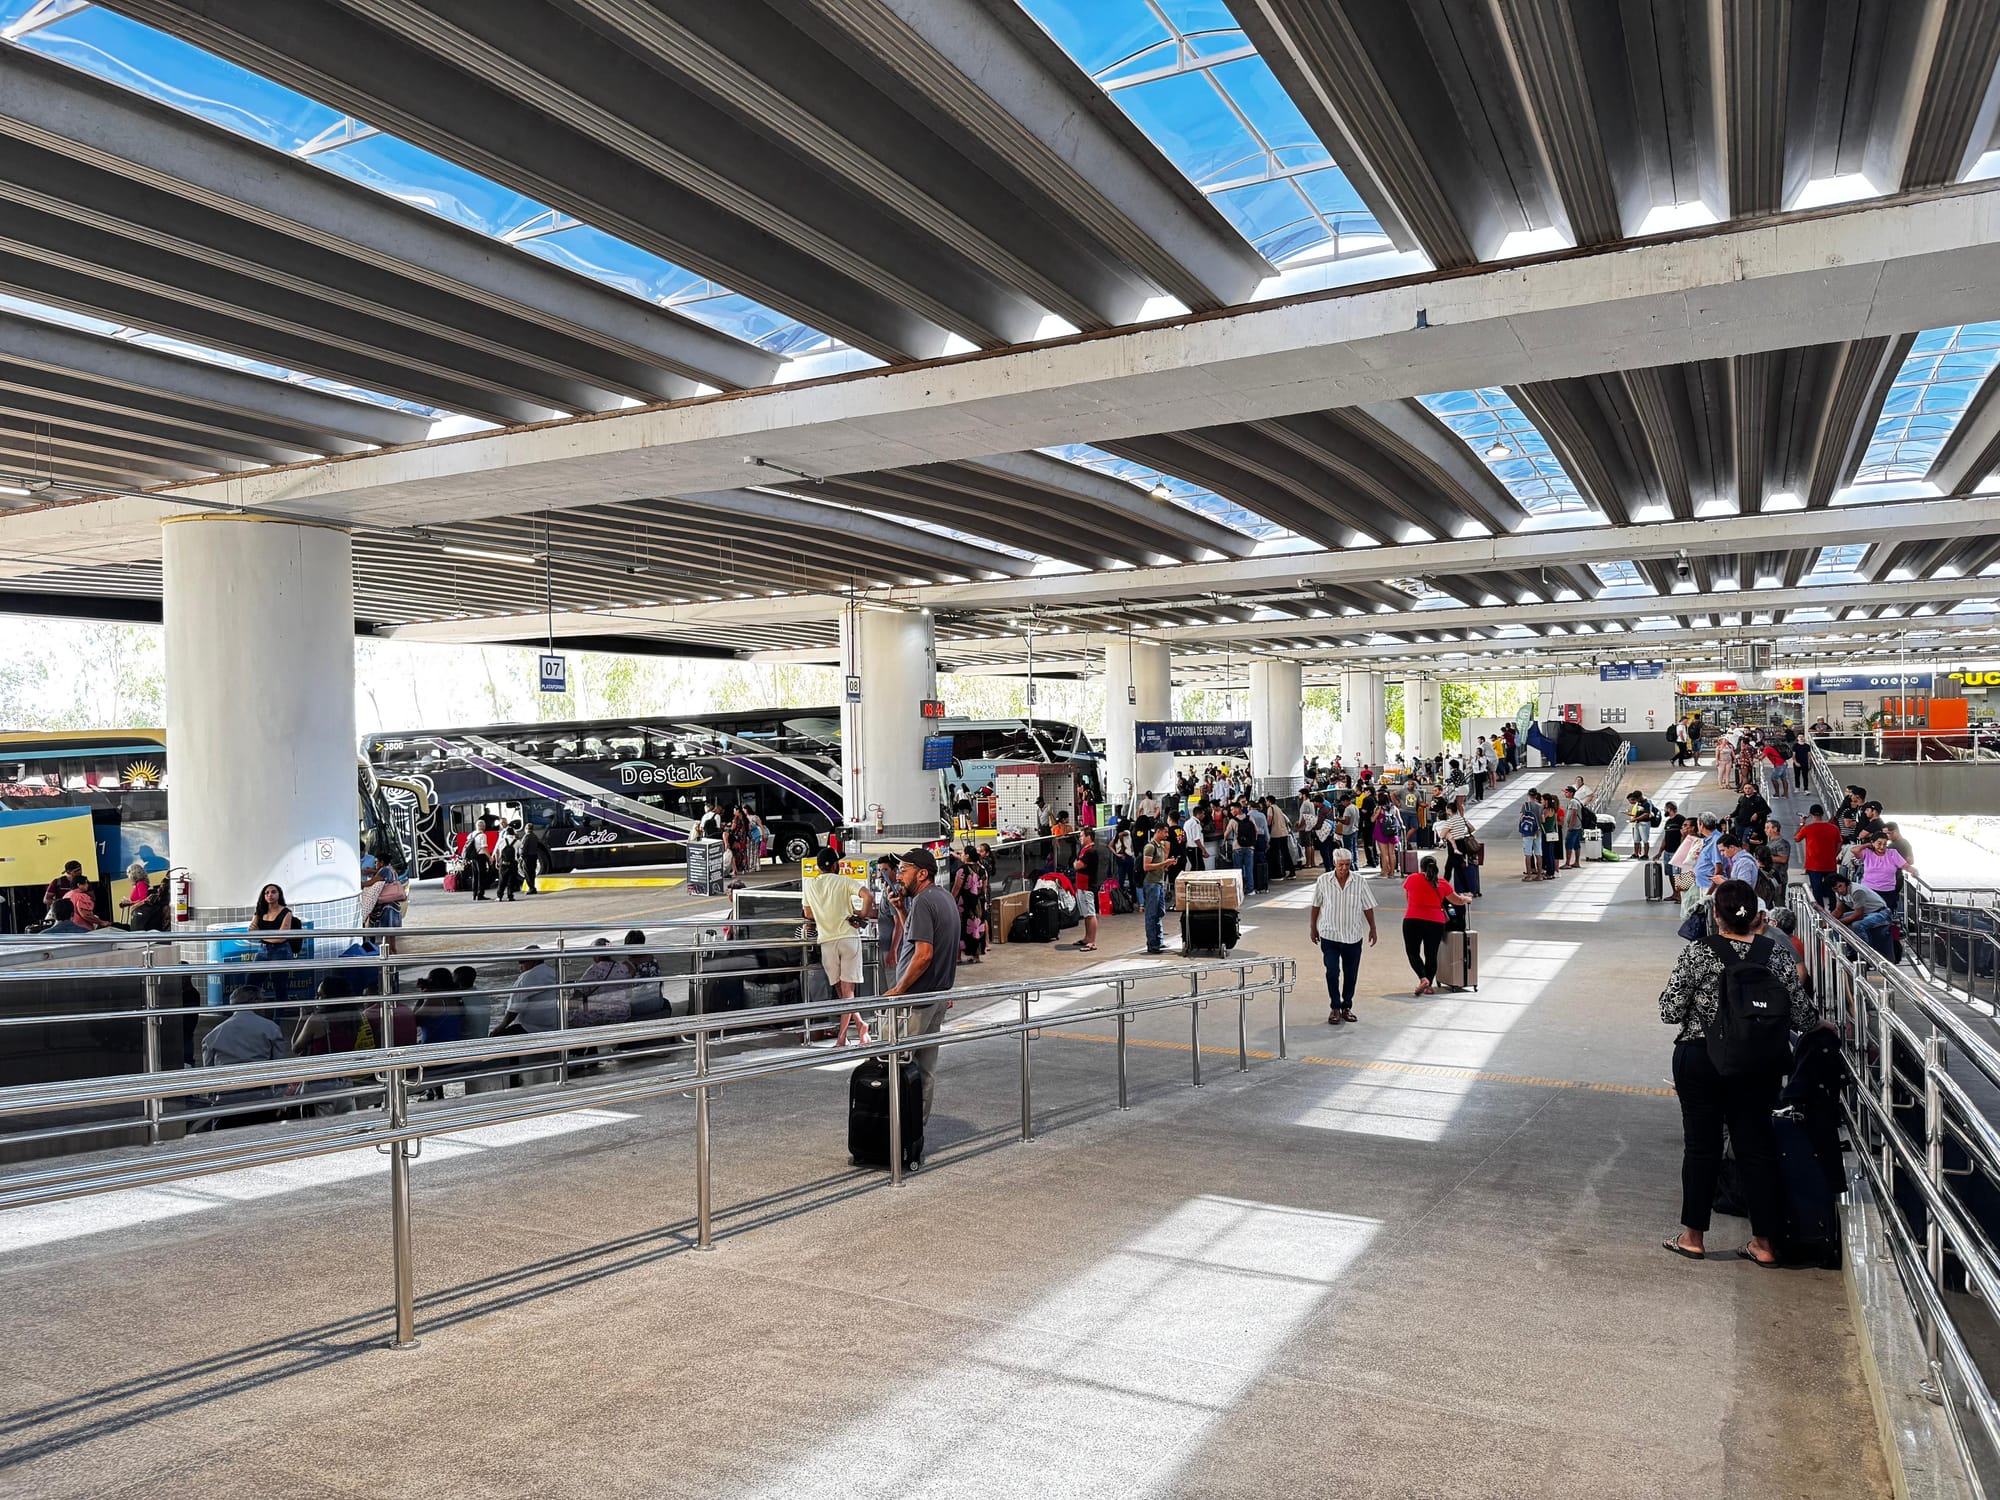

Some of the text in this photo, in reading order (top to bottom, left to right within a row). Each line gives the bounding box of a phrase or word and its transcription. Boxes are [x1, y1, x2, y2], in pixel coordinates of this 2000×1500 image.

[545, 662, 560, 677] 07
[849, 681, 858, 692] 08
[1165, 725, 1227, 737] PLATAFORMA DE EMBARQUE
[384, 742, 404, 751] 3800
[621, 763, 704, 786] Destak
[566, 829, 618, 846] Leito
